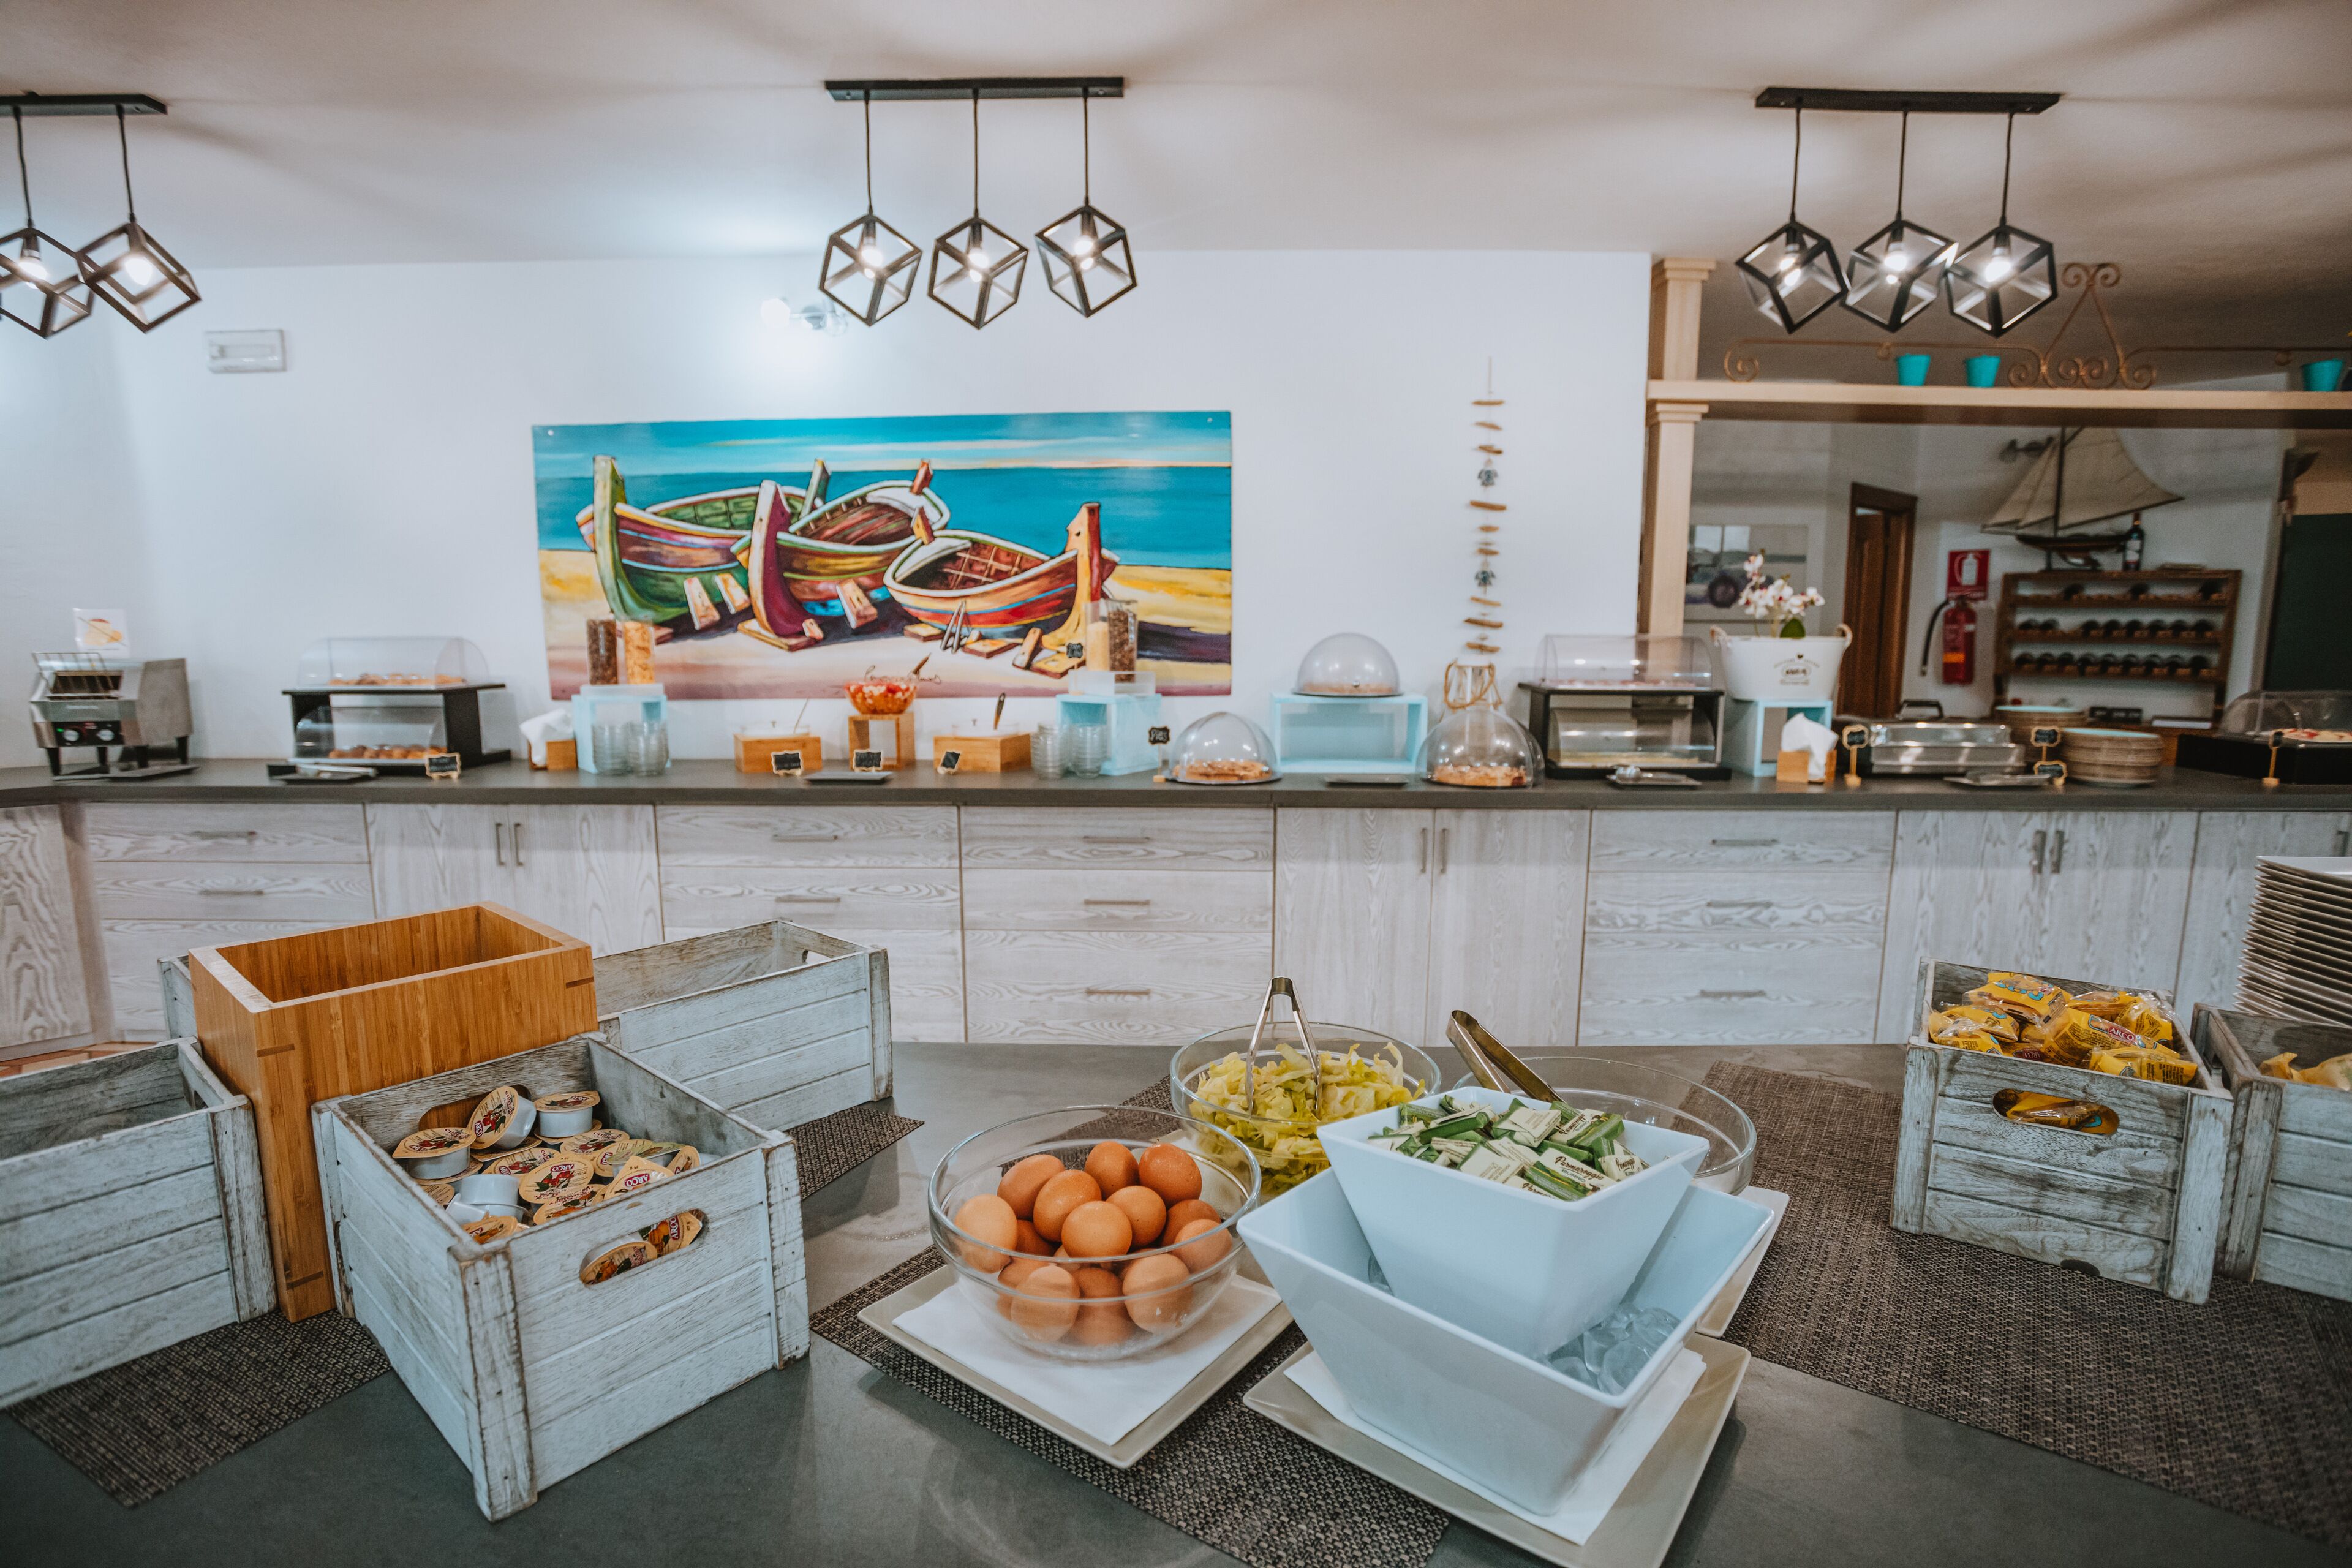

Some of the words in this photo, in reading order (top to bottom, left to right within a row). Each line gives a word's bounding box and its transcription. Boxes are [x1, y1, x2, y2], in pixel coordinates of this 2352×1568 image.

[2109, 1028, 2135, 1041] ARCO
[475, 1121, 483, 1137] ARCO
[500, 1166, 511, 1175] ARCO
[552, 1164, 573, 1172] ARCO
[1555, 1156, 1605, 1181] Parmareggio
[626, 1174, 649, 1187] ARCO
[1561, 1169, 1586, 1183] BURRO
[670, 1216, 679, 1240] ARCO
